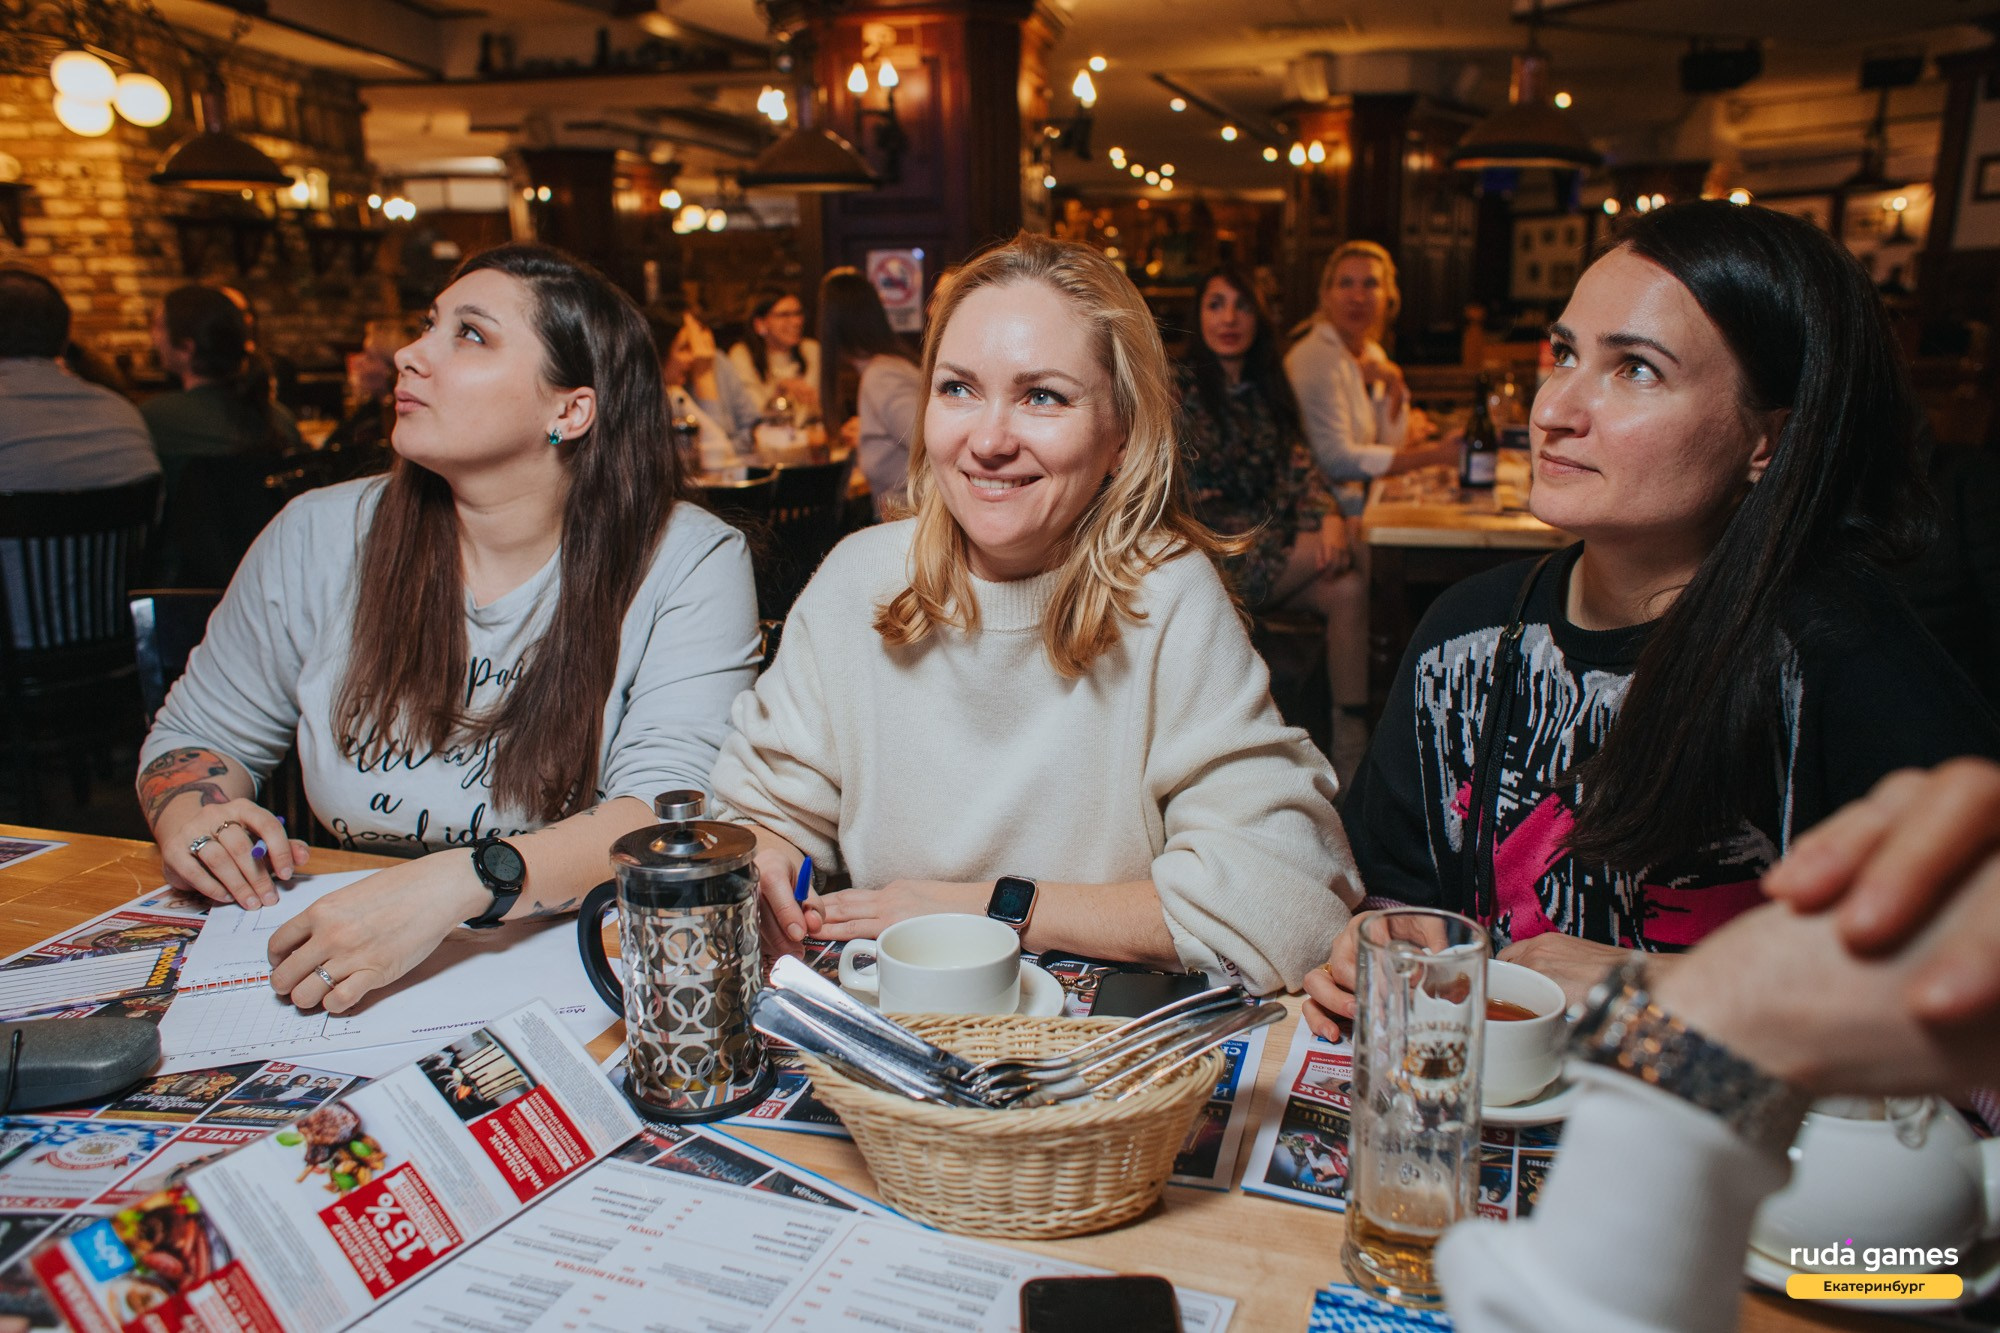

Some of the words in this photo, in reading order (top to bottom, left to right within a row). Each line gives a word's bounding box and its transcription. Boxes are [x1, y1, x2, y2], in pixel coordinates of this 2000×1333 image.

[332, 809, 430, 853] good
[369, 792, 403, 814] a
[487, 1116, 544, 1189] ИМЕНИННИКУ
[488, 1133, 526, 1181] ПОДАРОК
[330, 1221, 378, 1282] КАЖДОМУ
[332, 1203, 395, 1288] ИМЕНИННИКУ
[355, 1213, 396, 1264] СКИДКА
[362, 1188, 428, 1264] 15%
